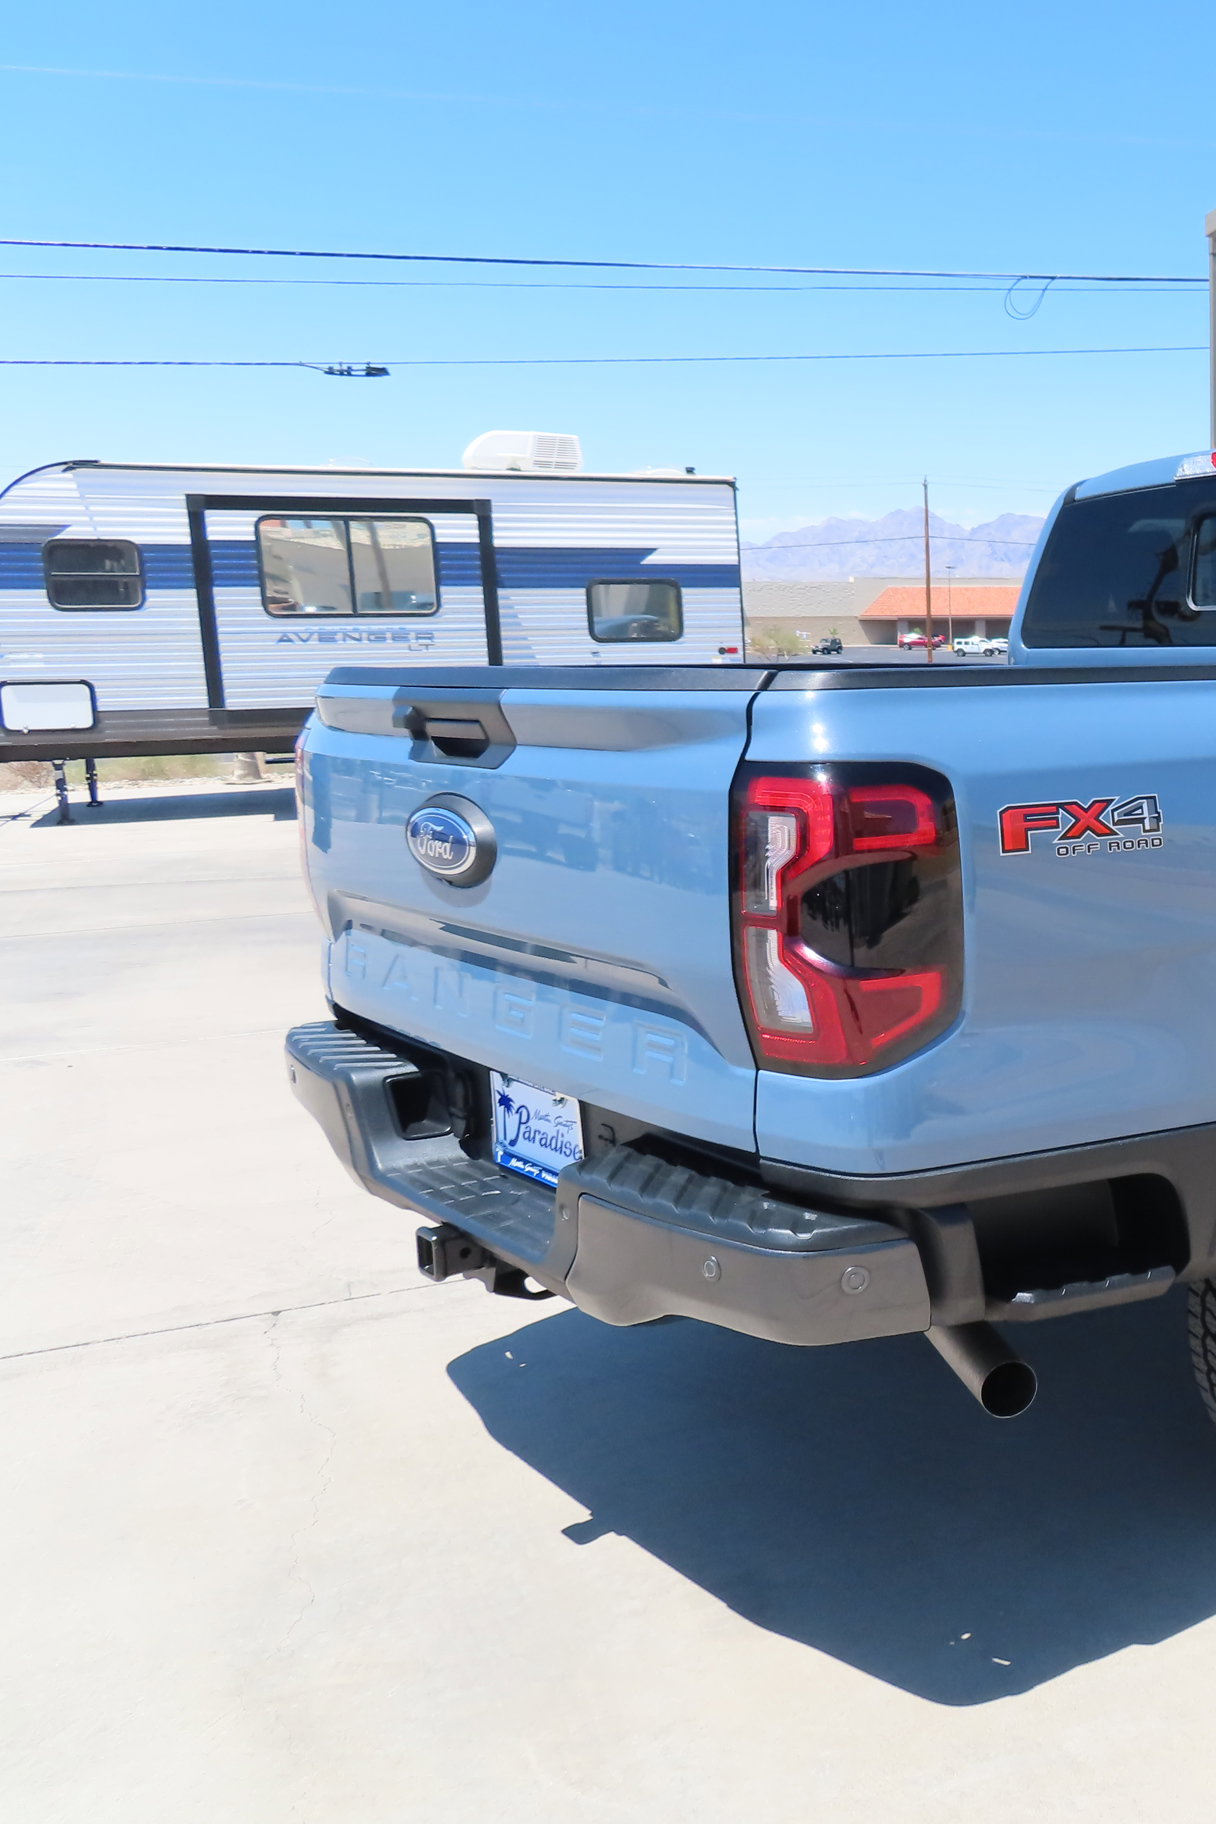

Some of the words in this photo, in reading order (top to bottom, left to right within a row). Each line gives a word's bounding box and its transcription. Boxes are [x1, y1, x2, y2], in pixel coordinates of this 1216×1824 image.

[276, 632, 435, 643] AVENGER
[408, 643, 435, 651] LT
[416, 821, 455, 861] Ford
[997, 794, 1163, 856] FX4
[1056, 842, 1100, 858] OFF
[1108, 837, 1163, 853] ROAD
[344, 934, 688, 1087] RANGER
[508, 1105, 583, 1161] Paradise
